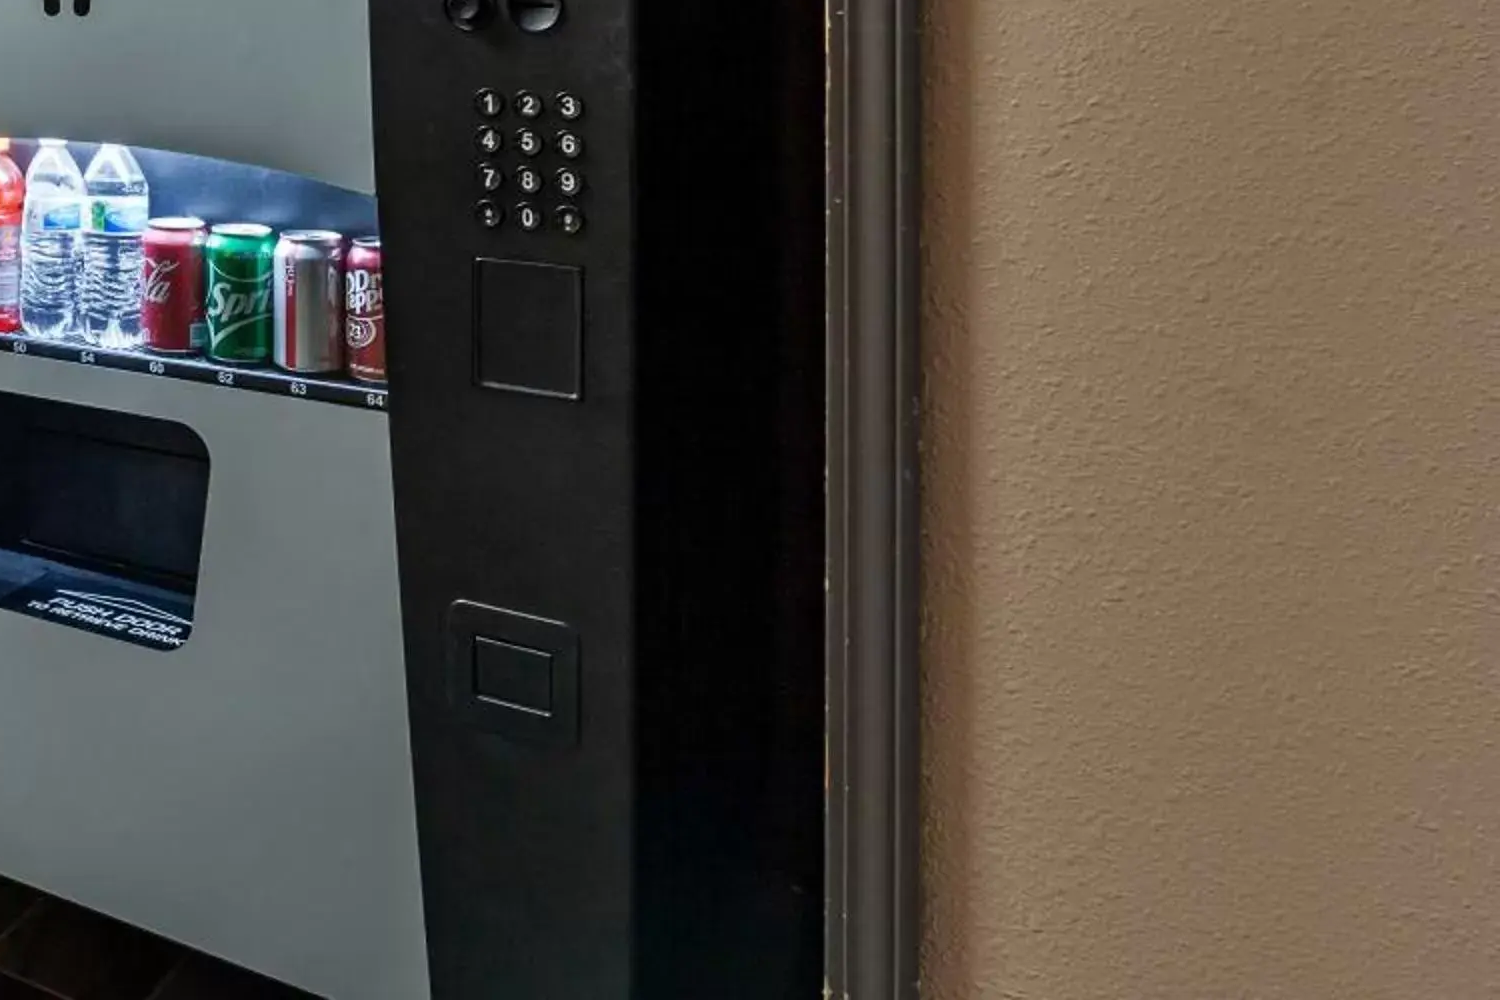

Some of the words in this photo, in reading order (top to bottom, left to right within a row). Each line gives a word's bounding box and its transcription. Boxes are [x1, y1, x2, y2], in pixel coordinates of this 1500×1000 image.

[484, 94, 493, 113] 1
[522, 96, 533, 113] 2
[561, 96, 575, 115] 3
[482, 130, 495, 148] 4
[521, 132, 533, 151] 5
[561, 135, 575, 153] 6
[484, 169, 495, 187] 7
[522, 171, 533, 189] 8
[560, 172, 575, 191] 9
[522, 208, 533, 227] 0
[218, 371, 234, 385] 62
[291, 381, 307, 395] 63
[367, 393, 384, 407] 64
